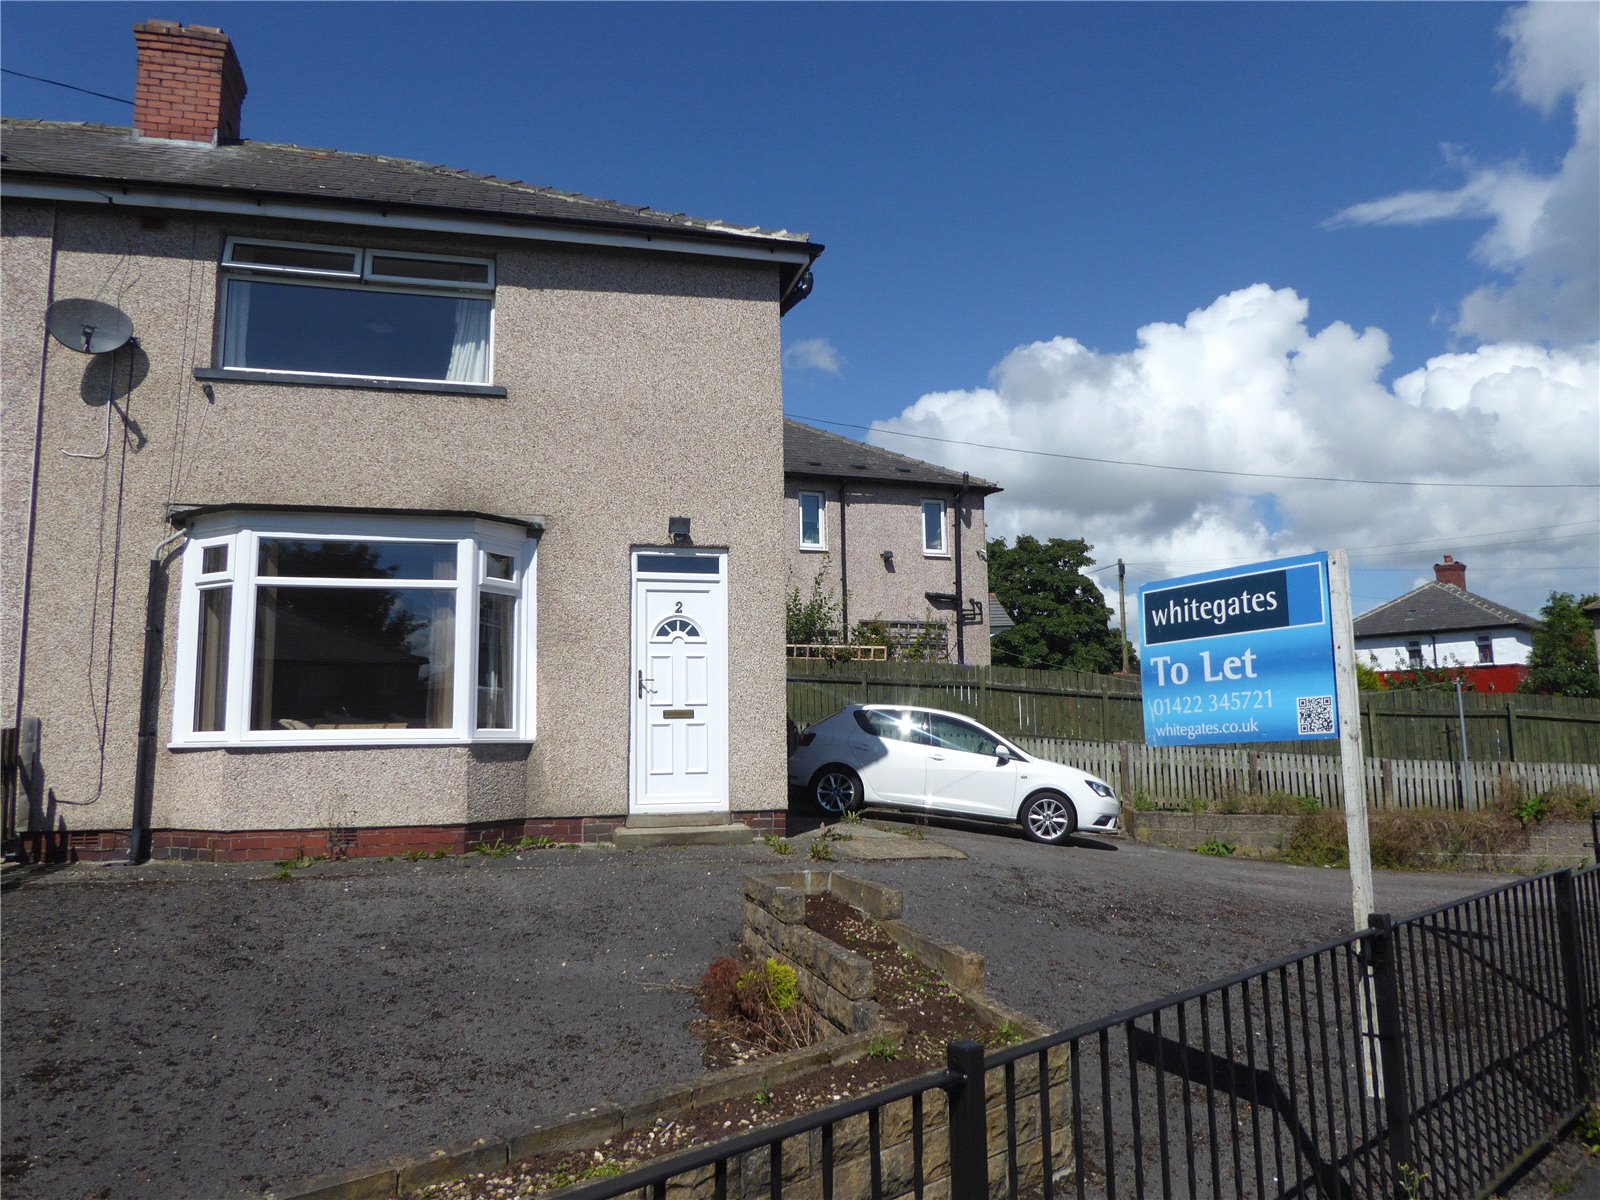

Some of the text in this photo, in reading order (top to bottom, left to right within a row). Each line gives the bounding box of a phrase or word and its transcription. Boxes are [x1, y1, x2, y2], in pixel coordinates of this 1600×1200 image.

[675, 601, 683, 613] 2
[1152, 590, 1277, 626] whitegates
[1150, 648, 1257, 686] To Let
[1153, 689, 1272, 715] 01422 345721
[1156, 717, 1258, 739] whitegates.co.uk
